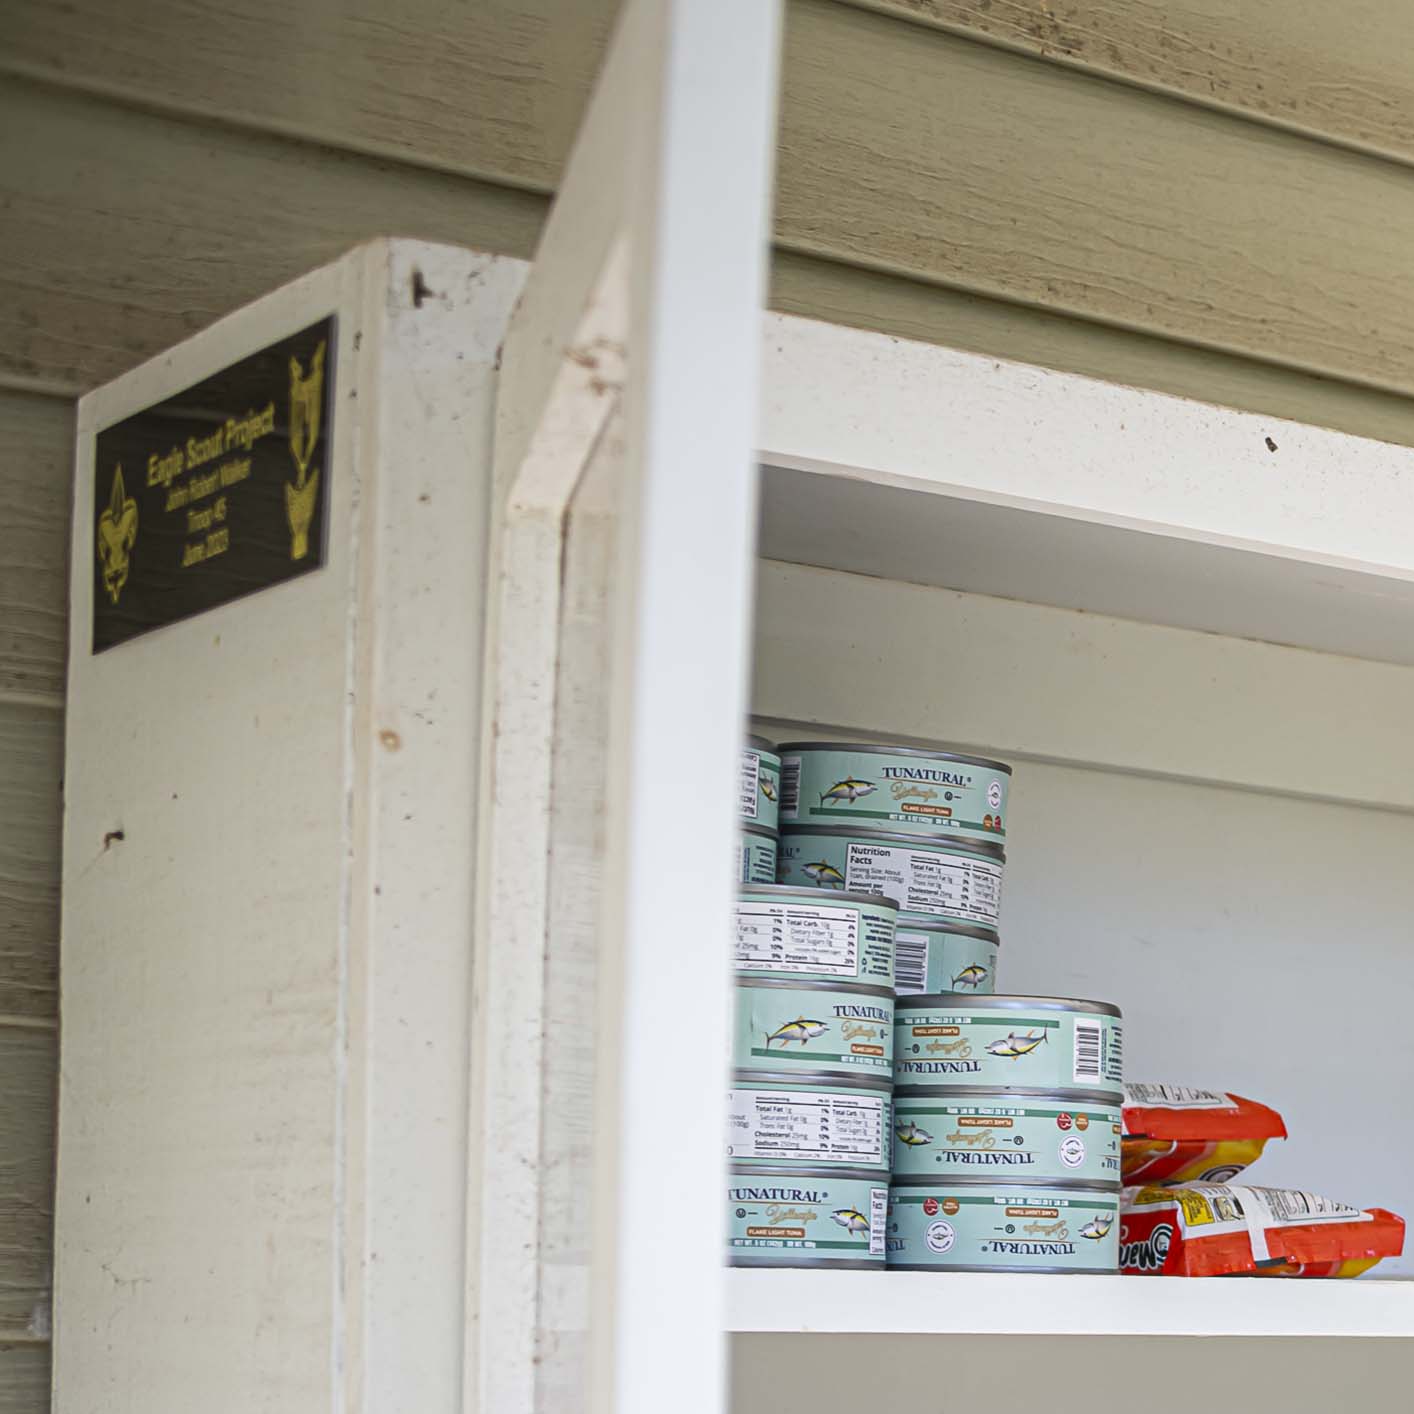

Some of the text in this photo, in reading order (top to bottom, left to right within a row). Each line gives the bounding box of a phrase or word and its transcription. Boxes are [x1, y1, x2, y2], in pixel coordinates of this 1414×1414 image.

[882, 767, 966, 787] TUNATURAL
[850, 846, 891, 857] Nutrition
[850, 856, 873, 865] Facts
[786, 919, 801, 927] Total
[785, 953, 808, 961] Protein
[756, 1105, 771, 1113] Total
[755, 1130, 791, 1138] Cholesterol
[754, 1139, 779, 1147] Sodium
[942, 1150, 1035, 1165] TUNATURAL
[988, 1241, 1075, 1255] TUNATURAL
